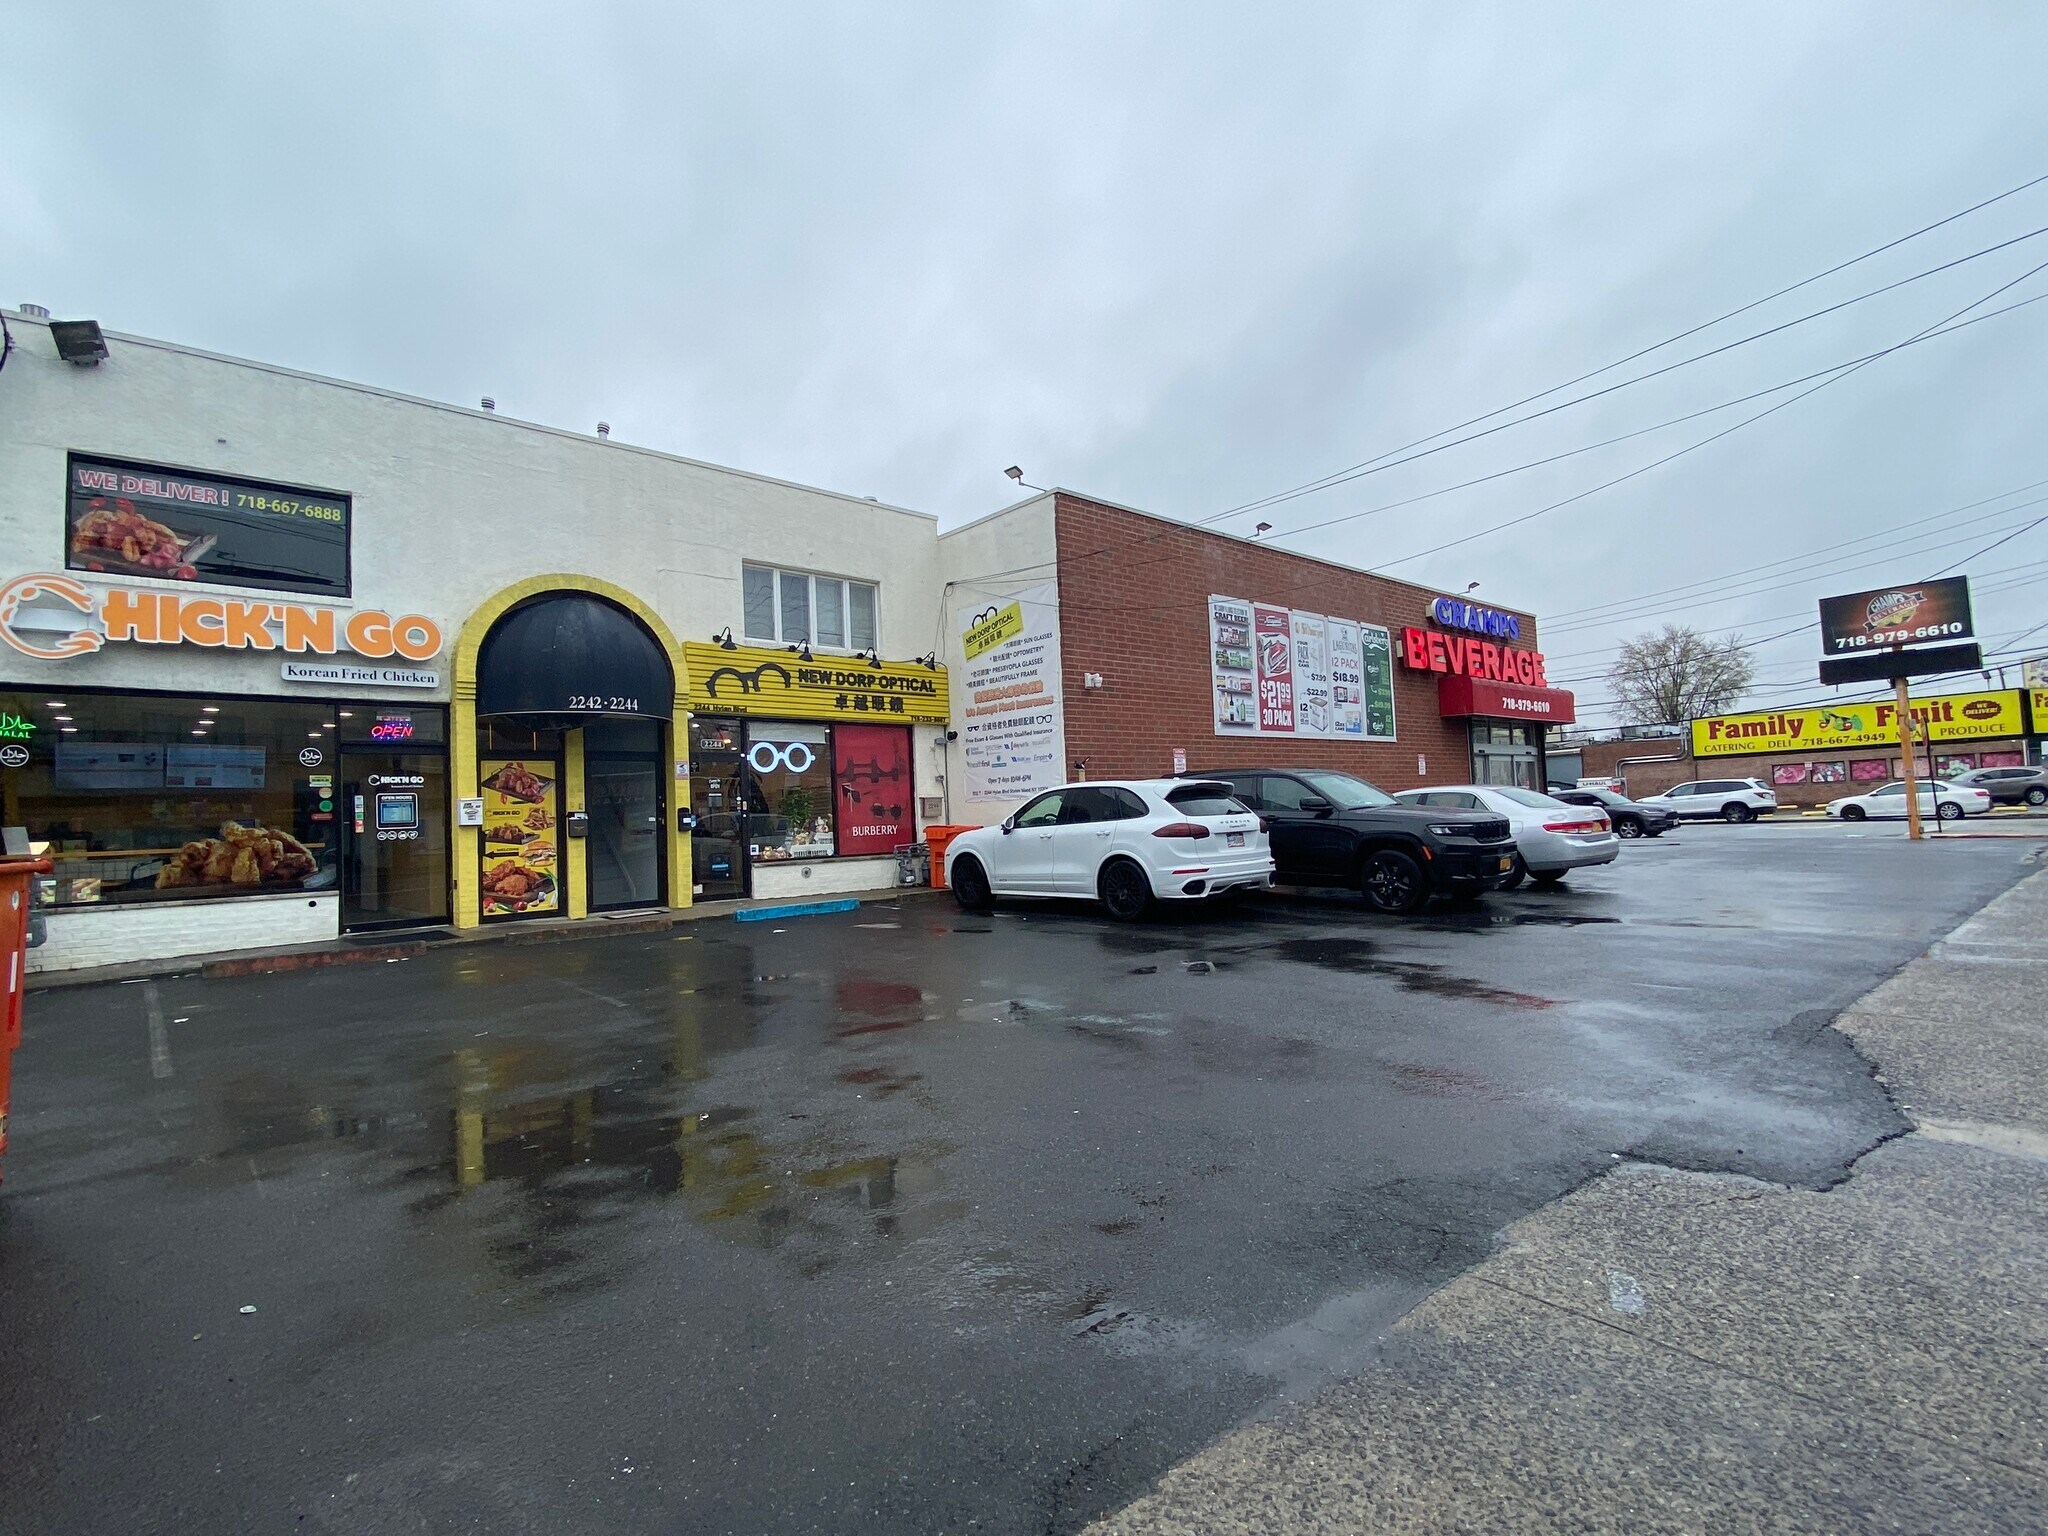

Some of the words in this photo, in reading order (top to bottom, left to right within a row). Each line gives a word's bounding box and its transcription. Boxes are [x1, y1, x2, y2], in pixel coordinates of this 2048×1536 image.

[78, 470, 117, 490] WE
[237, 494, 341, 521] 718-667-6888
[1870, 592, 1906, 613] CHAMPS
[1873, 600, 1915, 622] BEVERAGE
[1432, 598, 1519, 640] CHAMPS
[345, 609, 443, 661] GO
[1835, 622, 1963, 649] 718-979-6610
[1340, 658, 1359, 671] PACK
[1403, 627, 1547, 688] BEVERAGE
[287, 665, 338, 679] Korean
[342, 668, 377, 681] Fried
[383, 670, 435, 684] Chicken
[798, 668, 832, 685] NEW
[835, 672, 876, 689] DORP
[879, 676, 937, 693] OPTICAL
[1311, 673, 1327, 682] $7.99
[1333, 671, 1359, 684] $18.99
[1307, 688, 1328, 697] $22.99
[1300, 703, 1308, 711] 12
[1502, 697, 1550, 713] 718-979-6610
[1262, 709, 1273, 725] 30
[1273, 709, 1293, 727] PACK
[1708, 714, 1804, 740] Family
[1875, 701, 1954, 728] Fuit
[371, 725, 413, 738] OPEN
[1704, 741, 1756, 753] CATERING
[1768, 739, 1792, 749] DELI
[1802, 732, 1886, 747] 718-667-4949
[1940, 723, 2006, 736] PRODUCE
[852, 825, 898, 837] BURBERRY
